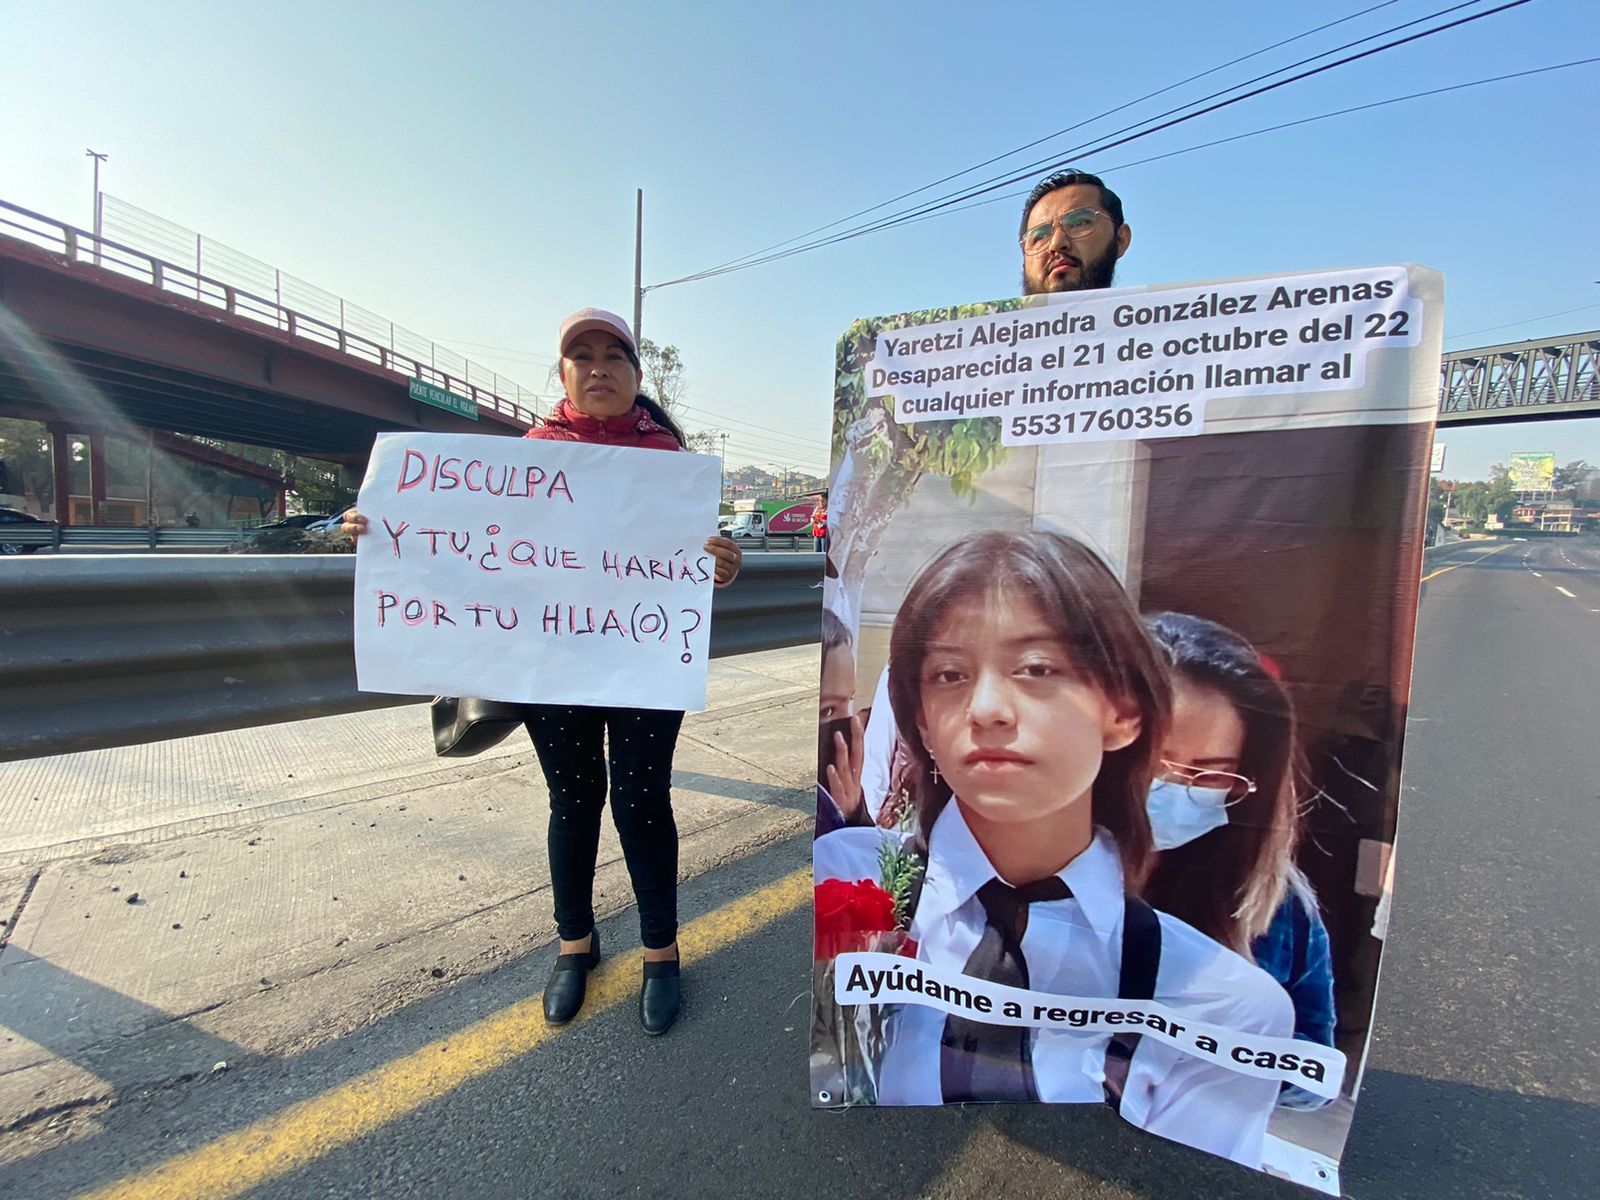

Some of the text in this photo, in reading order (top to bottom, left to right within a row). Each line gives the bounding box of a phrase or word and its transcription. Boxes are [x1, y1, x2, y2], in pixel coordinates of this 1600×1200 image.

[883, 278, 1395, 358] Yaretzi Alejandra González Arenas
[871, 310, 1410, 389] Desaparecida el 21 de octubre del 22
[452, 397, 458, 409] EL
[901, 354, 1352, 418] cualquier información llamar al
[1010, 404, 1193, 437] 5531760356
[397, 448, 575, 503] DISCULPA
[382, 516, 411, 559] Y
[375, 590, 457, 628] POR
[464, 604, 518, 630] TU
[845, 964, 1326, 1082] Ayúdame a regresar a casa
